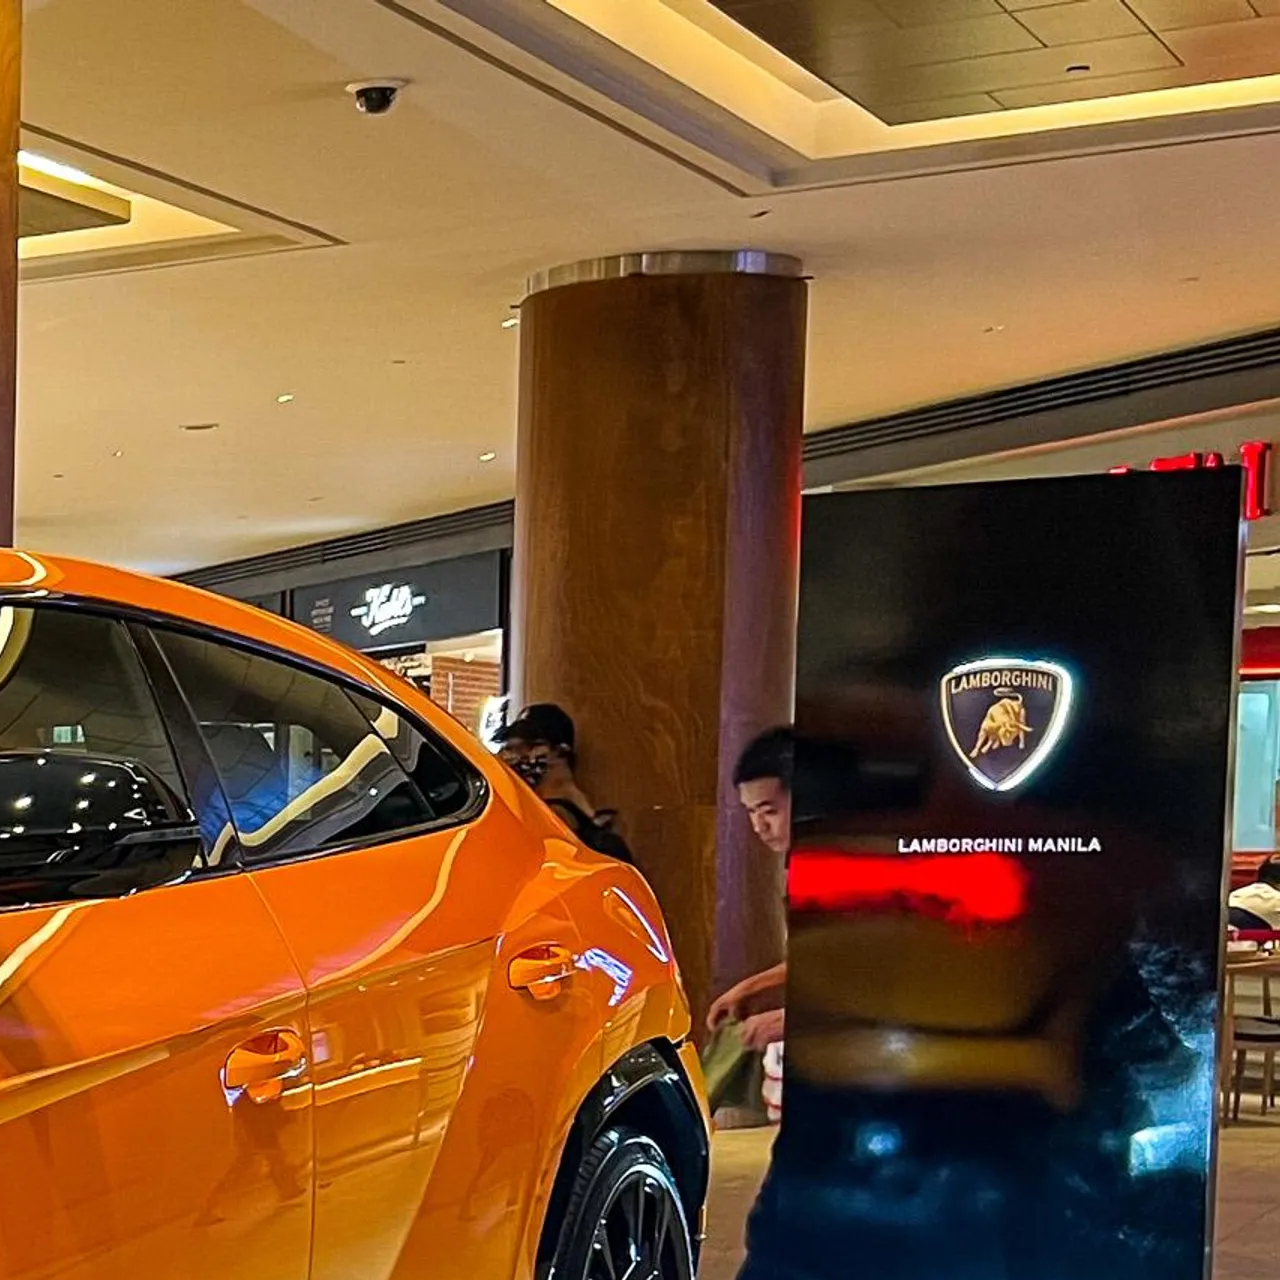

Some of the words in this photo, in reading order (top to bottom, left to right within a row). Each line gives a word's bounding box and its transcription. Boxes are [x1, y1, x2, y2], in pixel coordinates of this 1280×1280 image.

[951, 669, 1054, 695] LAMBORGHINI
[897, 837, 1023, 853] LAMBORGHINI
[1027, 836, 1102, 852] MANILA
